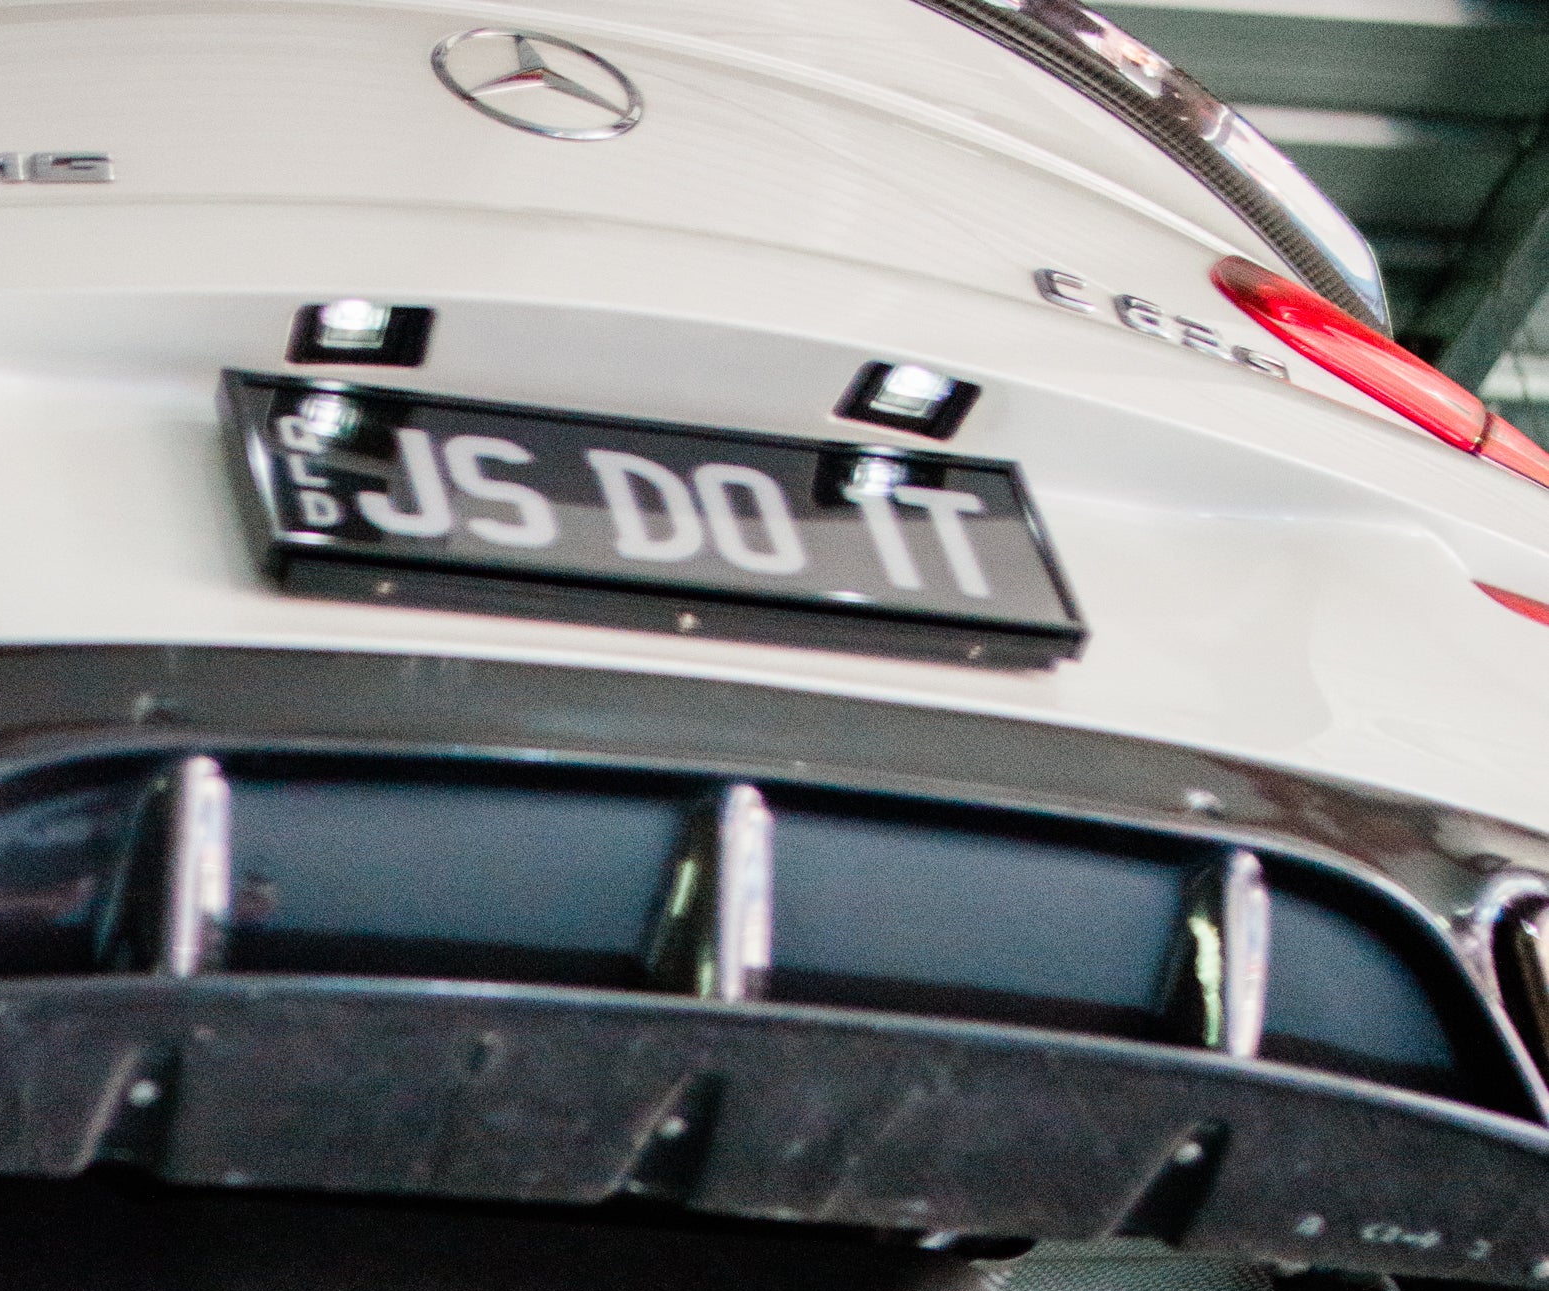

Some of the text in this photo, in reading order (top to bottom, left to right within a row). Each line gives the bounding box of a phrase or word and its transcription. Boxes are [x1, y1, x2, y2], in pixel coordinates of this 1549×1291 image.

[356, 427, 991, 600] JS DO IT
